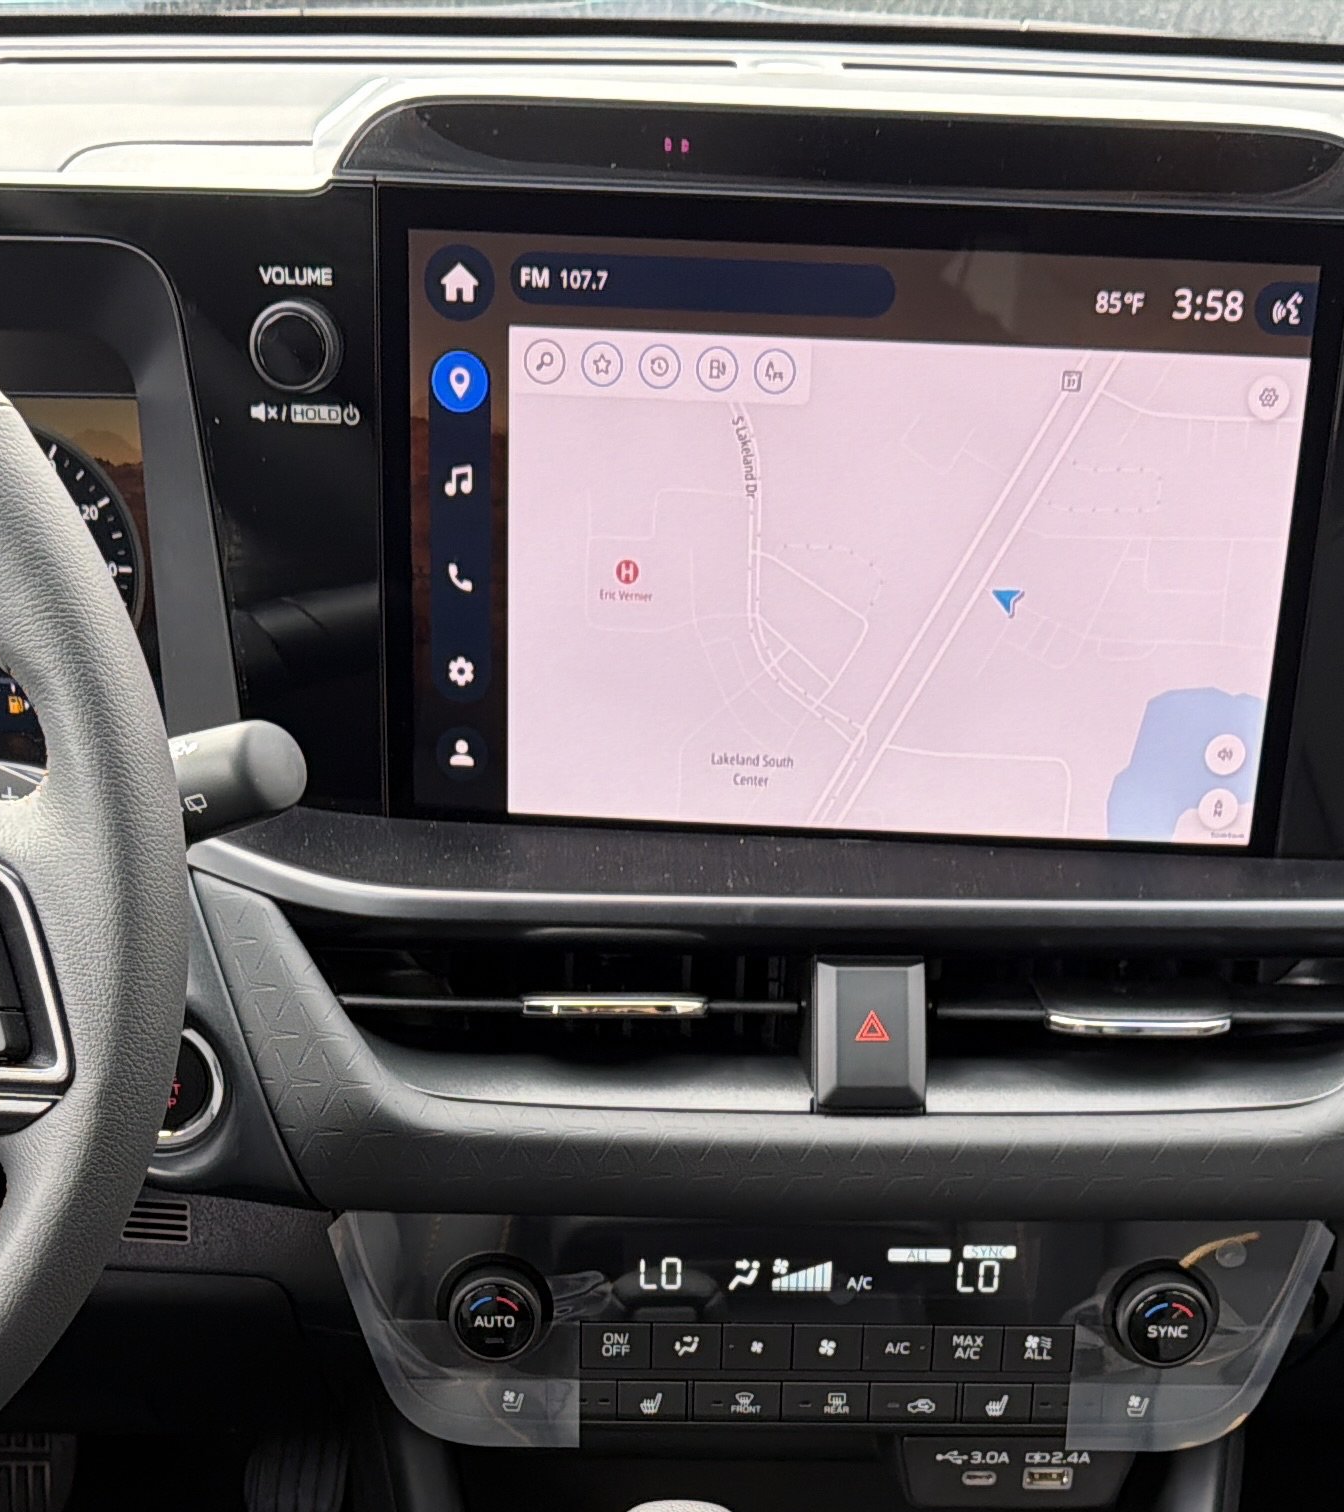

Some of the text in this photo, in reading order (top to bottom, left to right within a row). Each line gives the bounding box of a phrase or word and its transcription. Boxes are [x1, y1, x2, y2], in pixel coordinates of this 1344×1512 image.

[259, 265, 333, 286] VOLUME
[520, 267, 609, 291] FM 107.7
[1095, 291, 1145, 315] 85°F
[1171, 288, 1244, 322] 3:58
[293, 406, 340, 422] HOLD
[735, 427, 757, 482] Lakeland
[746, 484, 756, 500] Dr
[599, 588, 616, 601] Eric
[711, 753, 794, 769] Lakeland South
[733, 773, 769, 788] Center
[639, 1257, 682, 1291] LO
[956, 1260, 1000, 1293] LO
[846, 1275, 873, 1291] A/C
[473, 1315, 515, 1328] AUTO
[1147, 1325, 1189, 1339] SYNC
[884, 1341, 911, 1355] A/C
[952, 1335, 985, 1347] MAX
[602, 1344, 630, 1357] OFF
[954, 1347, 981, 1360] A/C
[1023, 1348, 1053, 1361] ALL
[730, 1404, 762, 1415] FRONT
[823, 1405, 850, 1415] REAR
[970, 1450, 1010, 1465] 3.0A
[1051, 1451, 1090, 1465] 2.4A
